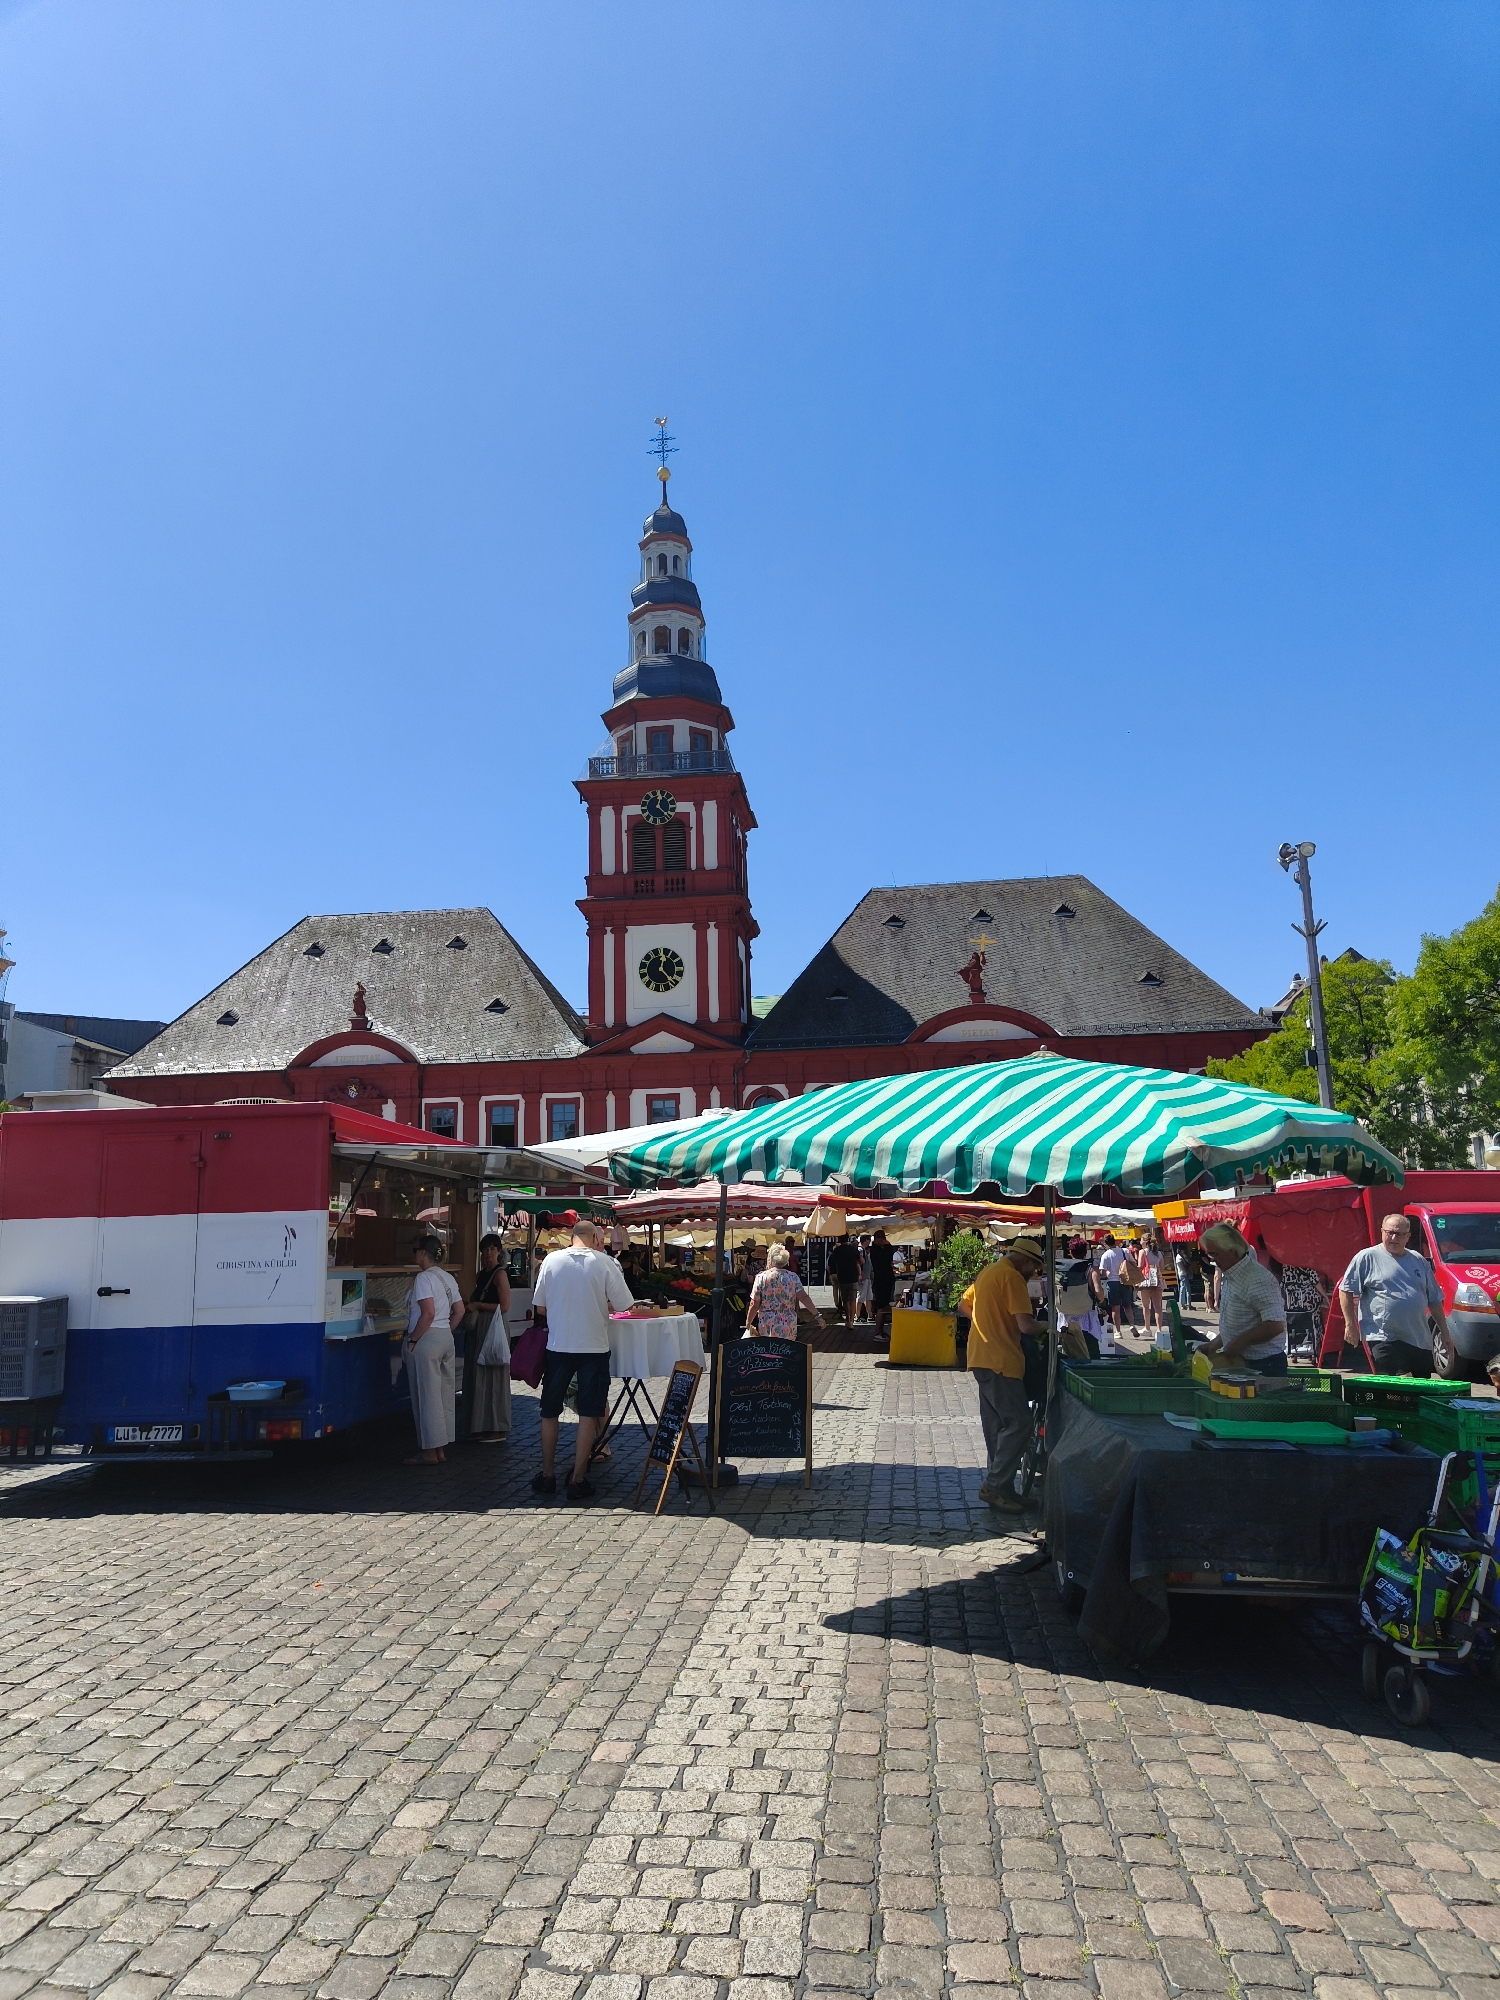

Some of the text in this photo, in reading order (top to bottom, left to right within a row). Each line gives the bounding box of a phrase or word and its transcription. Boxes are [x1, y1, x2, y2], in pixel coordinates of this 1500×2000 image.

[216, 1260, 262, 1270] CHRISTINA
[115, 1428, 130, 1441] LU
[153, 1427, 182, 1440] 7777
